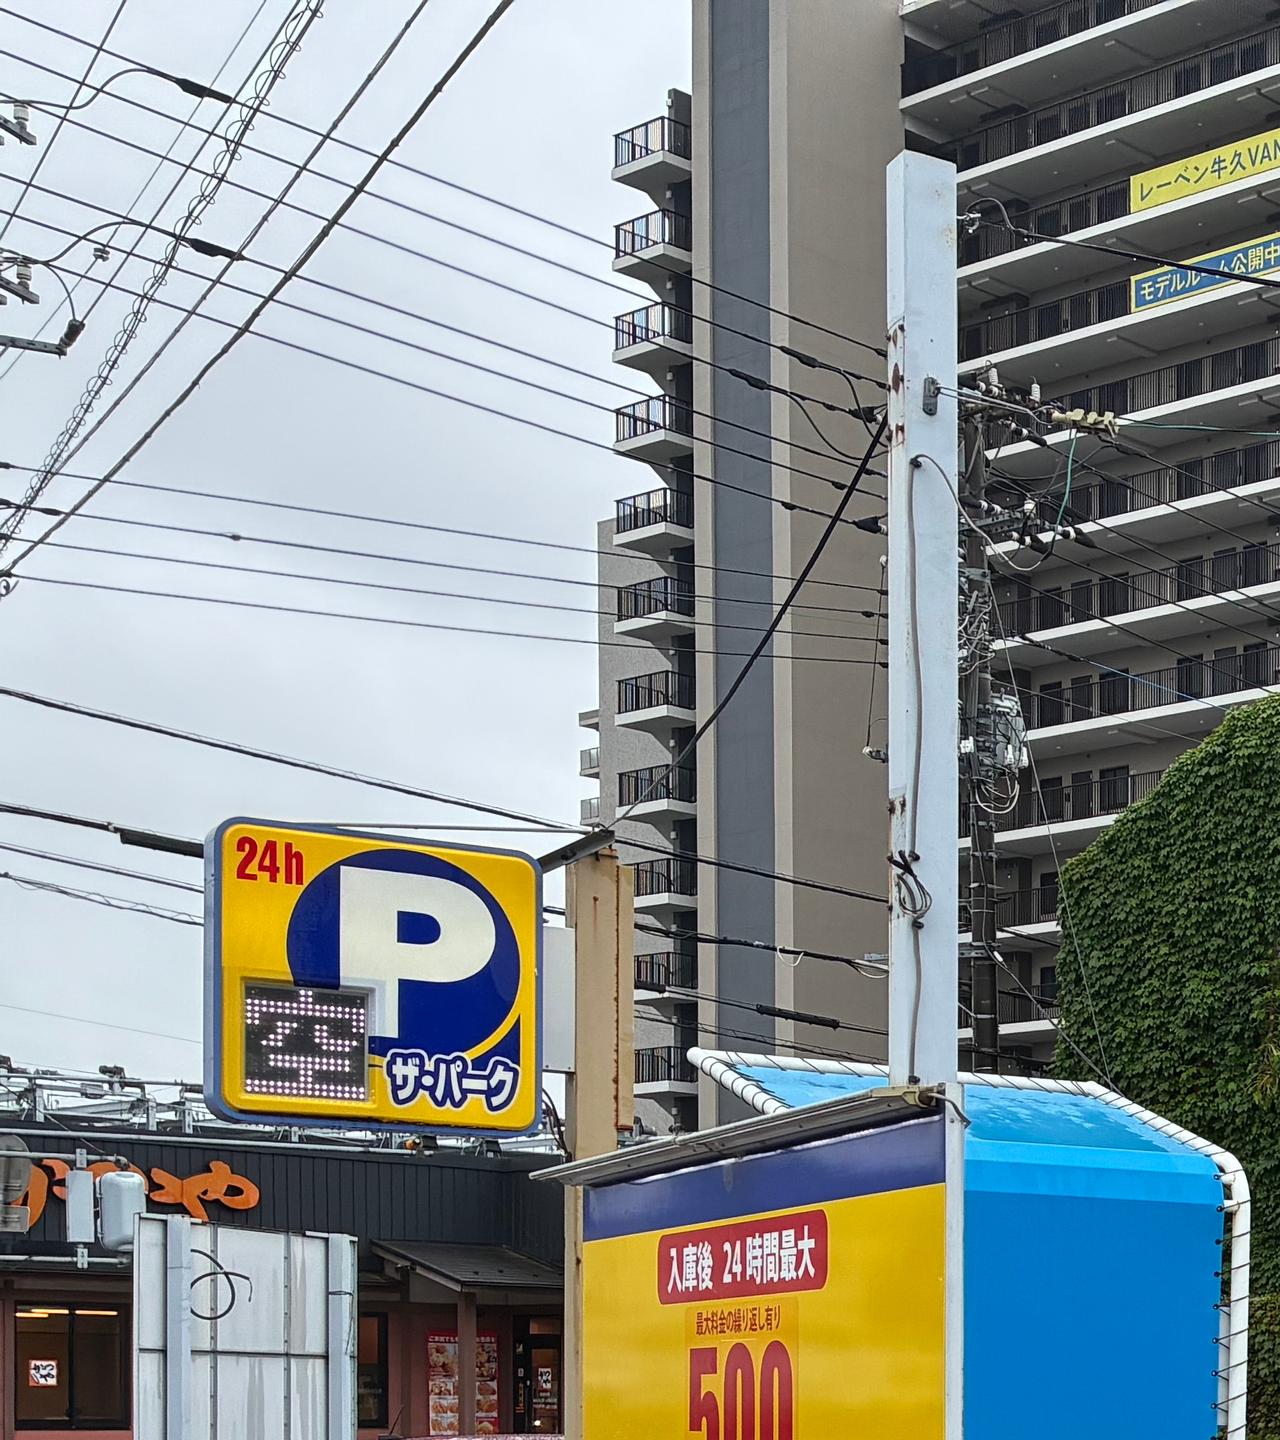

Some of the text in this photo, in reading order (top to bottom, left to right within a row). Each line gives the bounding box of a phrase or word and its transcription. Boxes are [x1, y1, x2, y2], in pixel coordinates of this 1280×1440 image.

[1140, 242, 1280, 301] モデルルム公開中
[236, 837, 303, 885] 24h
[340, 866, 496, 1038] P
[245, 990, 366, 1099] 空
[387, 1053, 517, 1111] ザ・パーク
[667, 1225, 816, 1294] 入庫後 24時間最大
[696, 1305, 780, 1336] 最大料金の繰り返し有り
